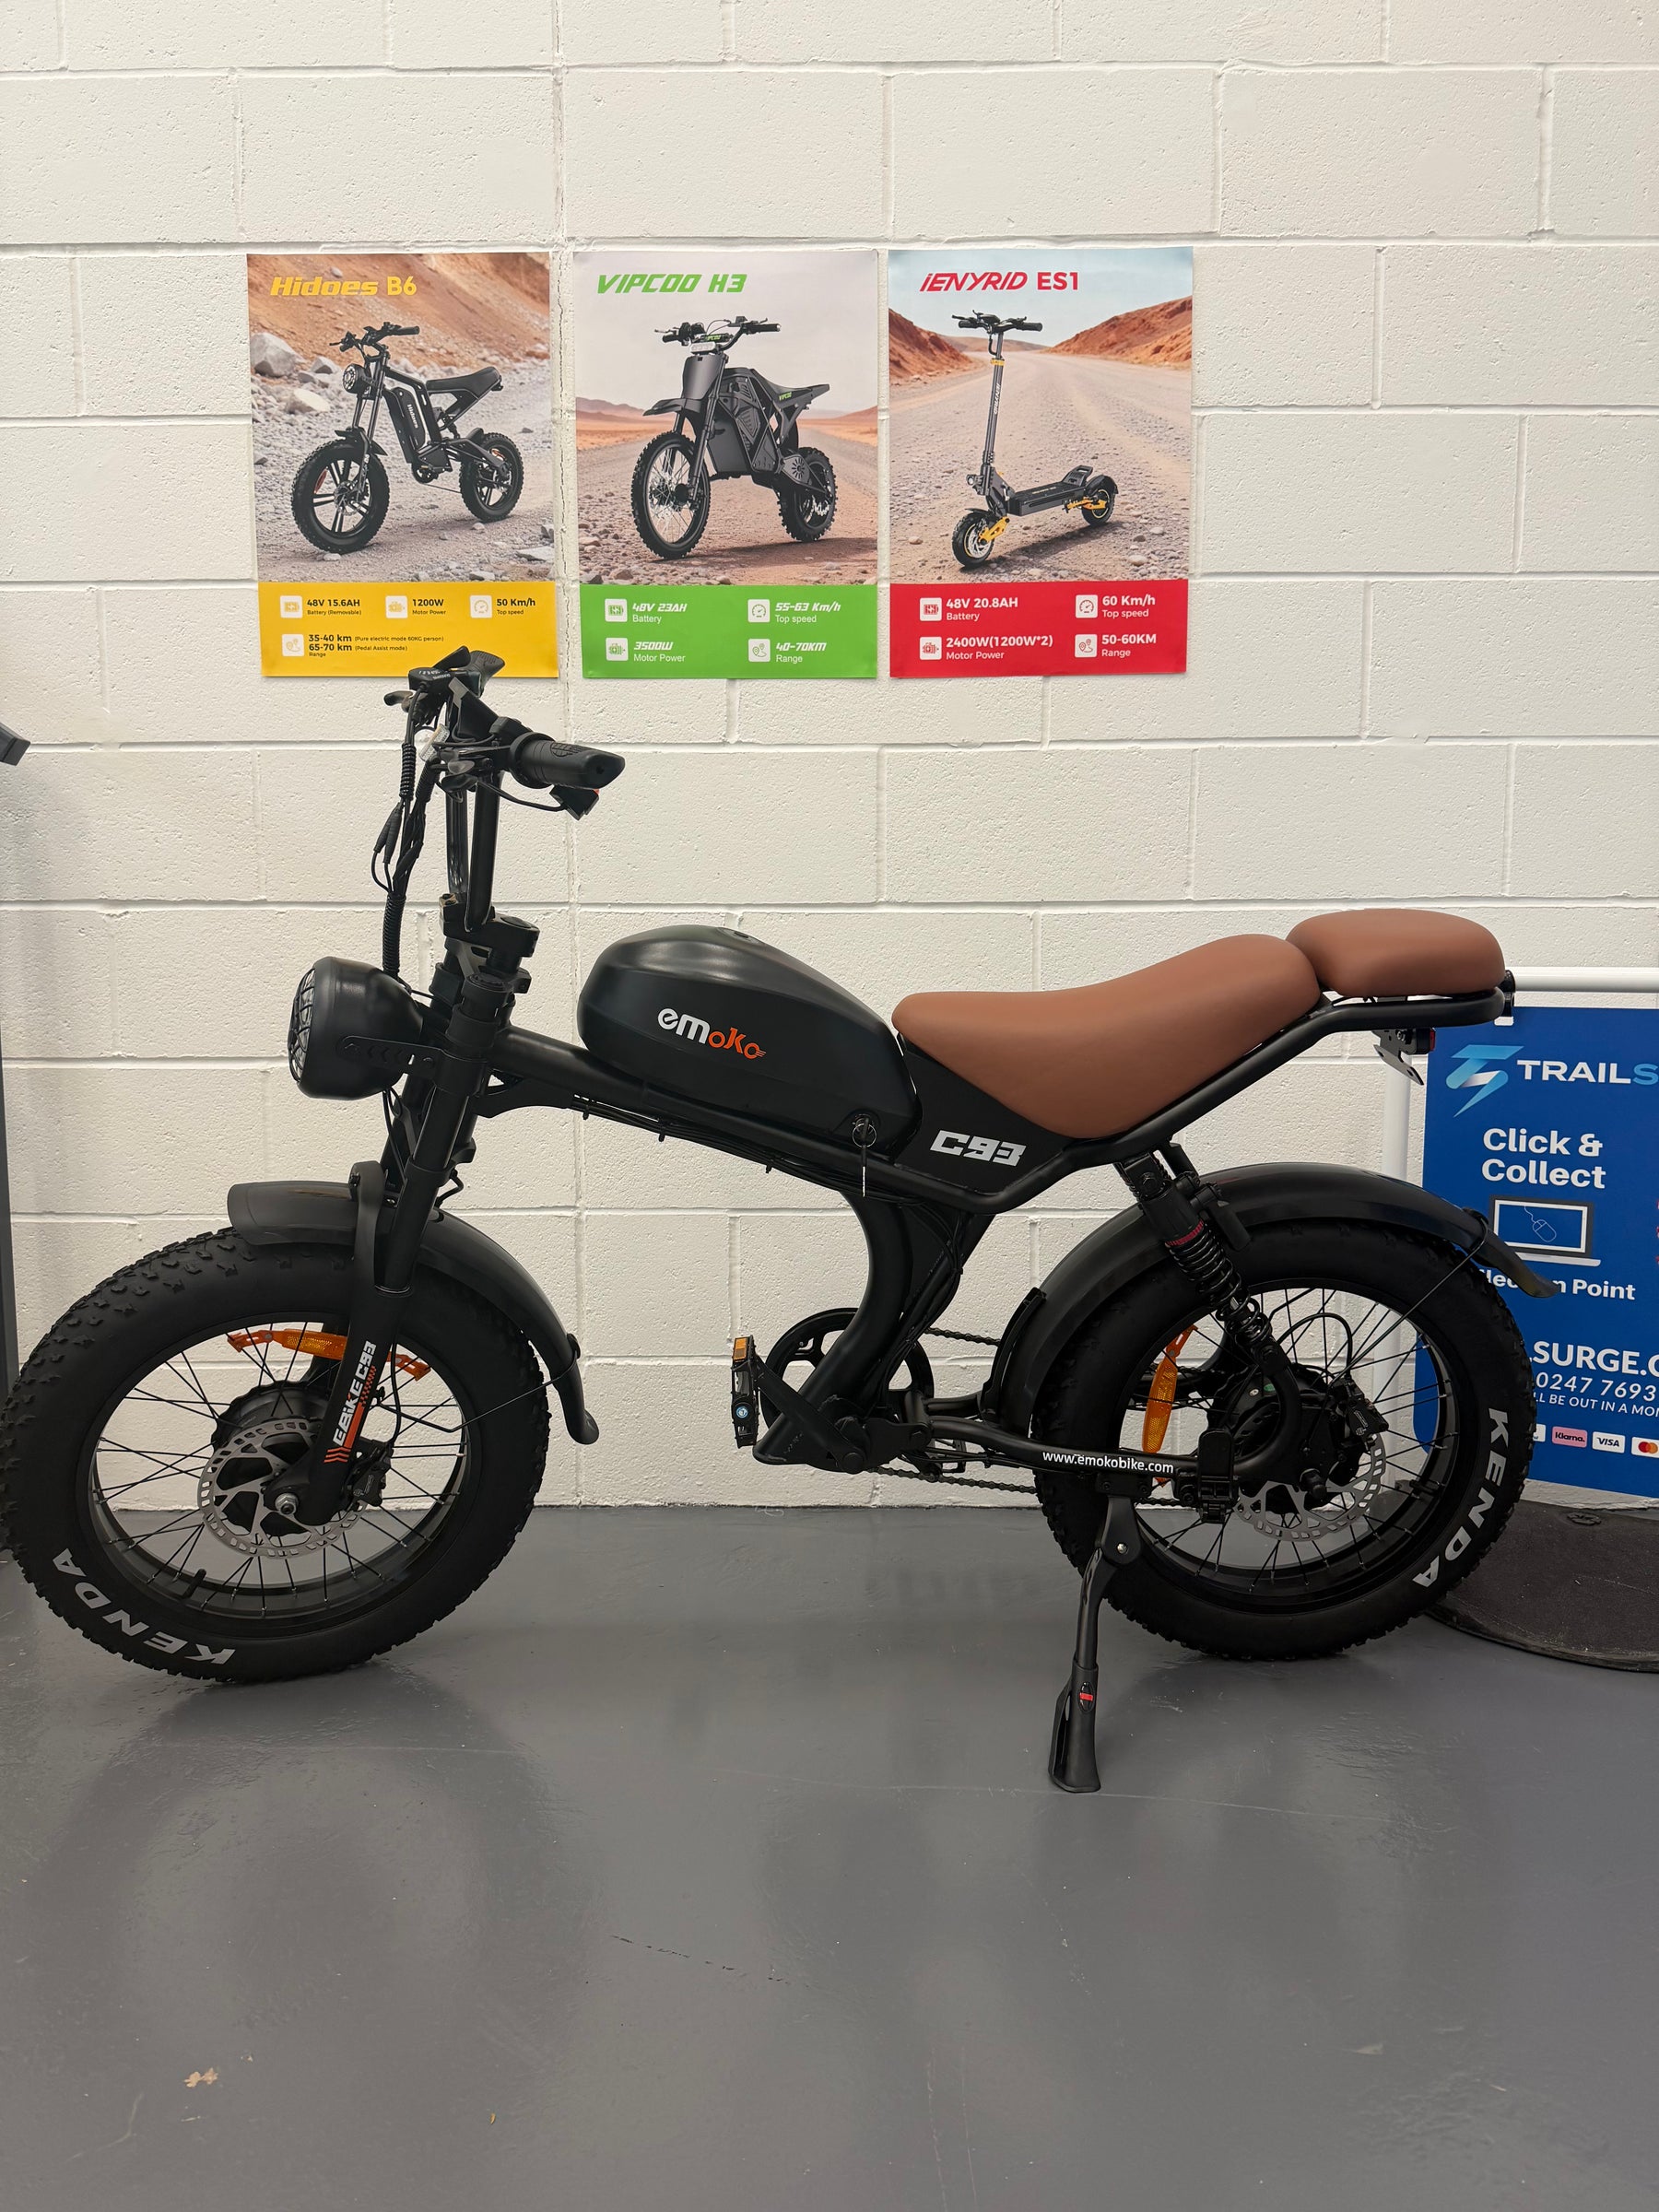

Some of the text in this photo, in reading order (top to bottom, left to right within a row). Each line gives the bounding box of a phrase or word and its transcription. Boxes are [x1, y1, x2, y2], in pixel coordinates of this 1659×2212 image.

[270, 276, 418, 296] Hidoes B6
[597, 273, 747, 294] VIPCOO H3
[1037, 272, 1078, 290] ES1
[412, 598, 444, 606] 1200W
[497, 597, 536, 606] 50 Km/h
[946, 597, 1018, 608] 48V 20.8AH
[1101, 594, 1156, 606] 60 Km/h
[632, 603, 688, 612] 48V 23AH
[775, 601, 841, 612] 55-63 Km/h
[947, 612, 980, 621] Battery
[1101, 608, 1149, 618] Top speed
[632, 615, 662, 624] Battery
[775, 615, 817, 624] Top speed
[309, 634, 335, 642] 35-40
[336, 634, 352, 642] km
[1101, 633, 1157, 644] 50-60KM
[309, 643, 335, 652] 65-70
[336, 643, 352, 652] km
[633, 641, 674, 651] 3500W
[775, 642, 827, 652] 40-70KM
[946, 651, 1005, 660] Motor Power
[1101, 649, 1131, 658] Range
[775, 655, 803, 664] Range
[1516, 1059, 1659, 1086] TRAILS
[1483, 1127, 1603, 1157] Click &
[929, 1129, 1027, 1167] C93
[1481, 1158, 1606, 1189] Collect
[1571, 1278, 1636, 1300] Point
[1535, 1371, 1656, 1402] 0247 7693
[1549, 1394, 1566, 1406] BE
[1569, 1396, 1598, 1409] OUT
[1601, 1401, 1616, 1412] IN
[1618, 1403, 1628, 1414] A
[1597, 1437, 1619, 1447] VISA
[1042, 1452, 1174, 1474] www.emokobike.com
[1412, 1407, 1509, 1588] KENDA
[53, 1547, 236, 1665] KENDA
